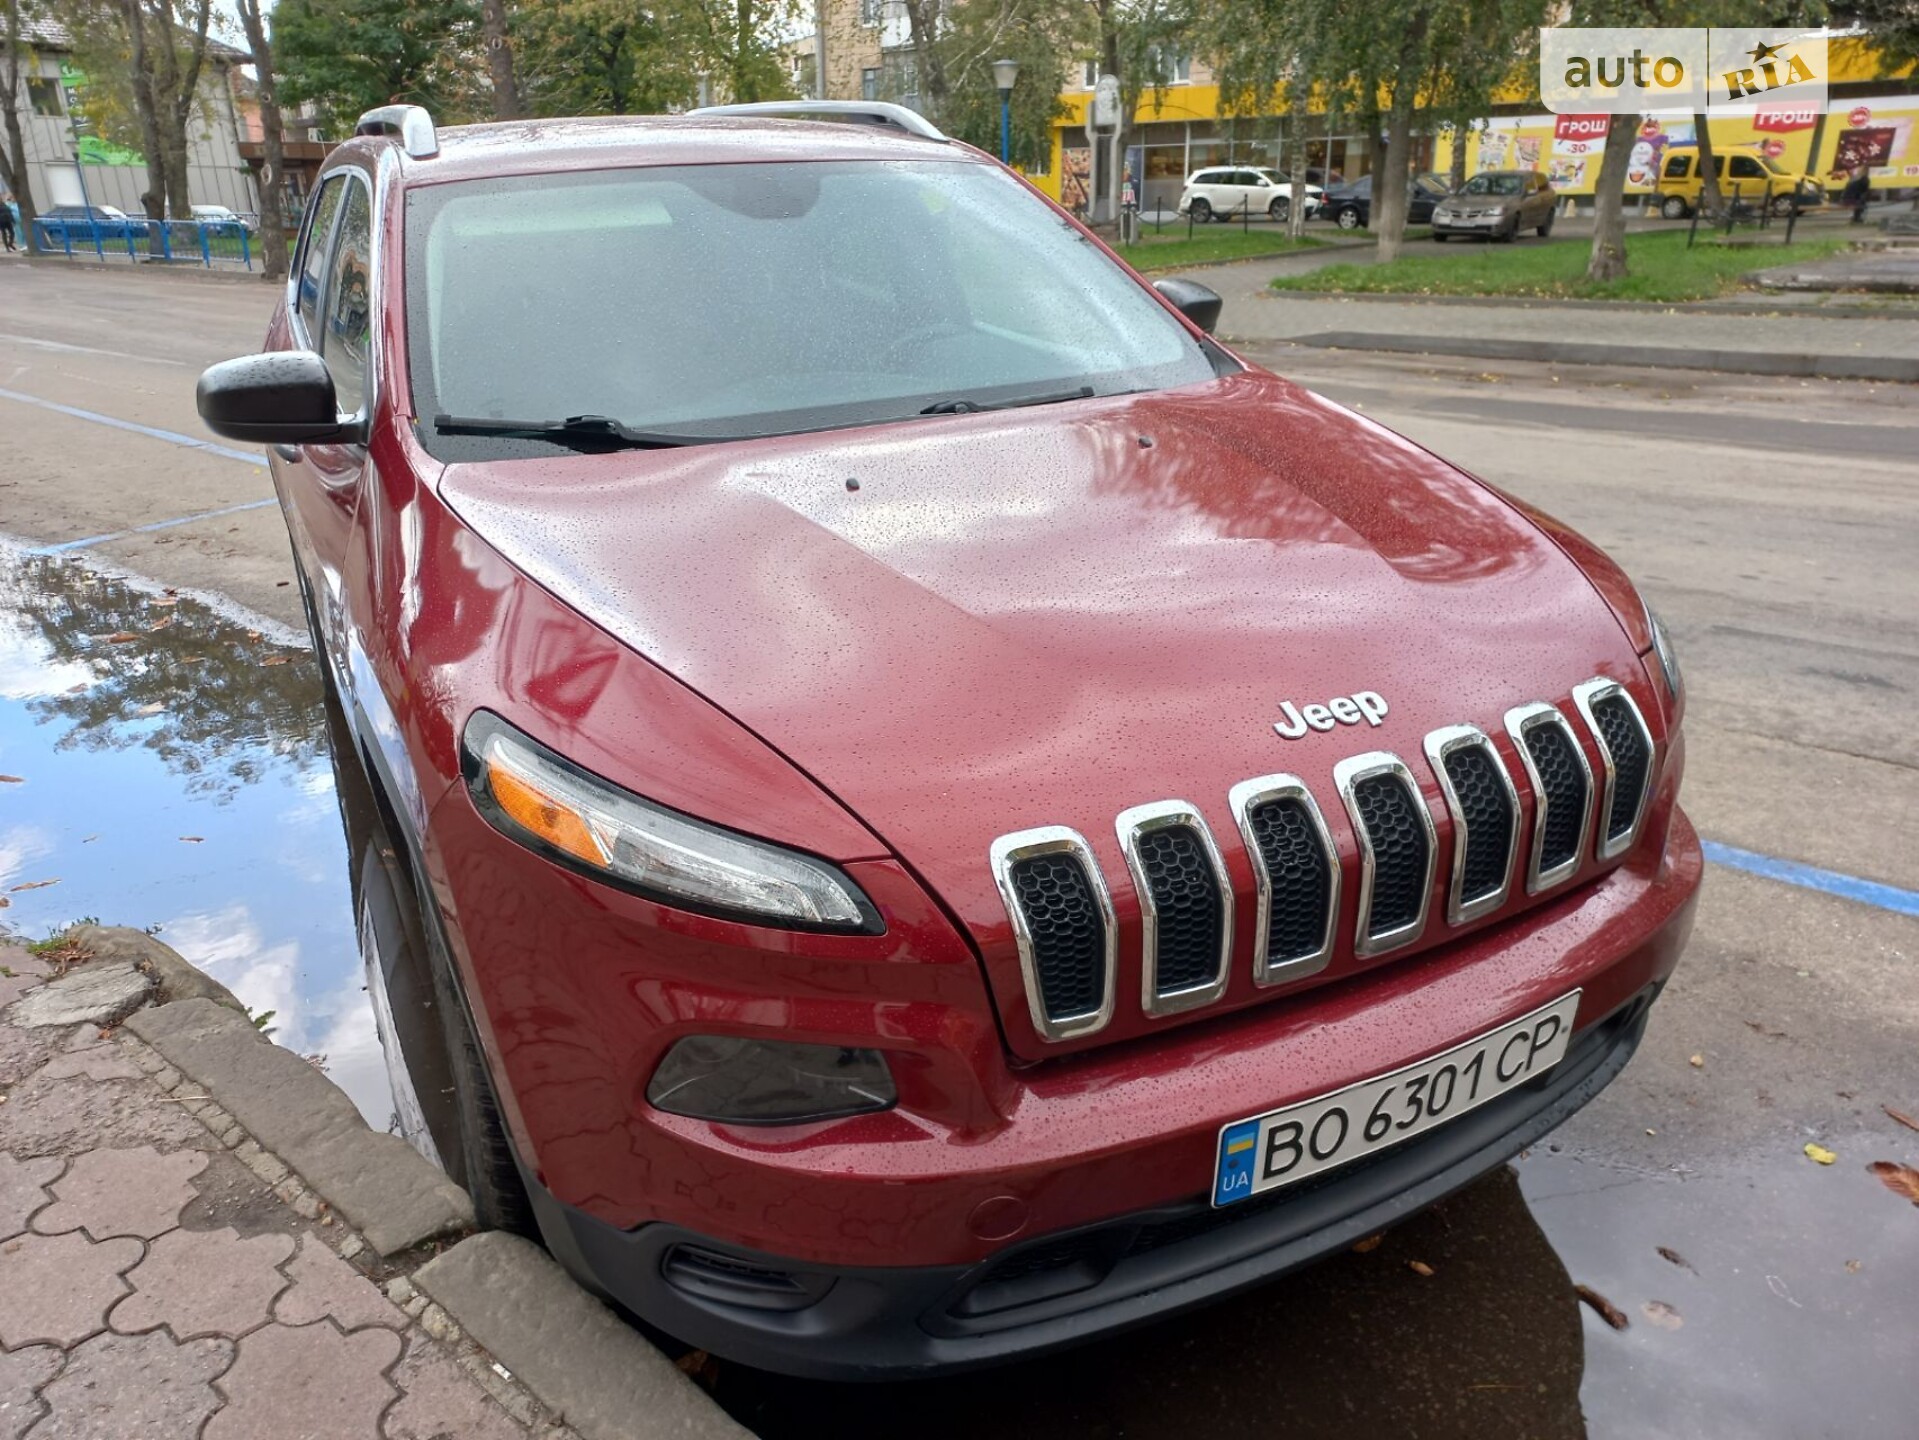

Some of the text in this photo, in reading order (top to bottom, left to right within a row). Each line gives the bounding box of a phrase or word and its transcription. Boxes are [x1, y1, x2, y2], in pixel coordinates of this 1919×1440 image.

[1559, 120, 1606, 134] ГРОШ
[1758, 110, 1815, 126] ГРОШ
[1273, 691, 1389, 740] Jeep
[1262, 1014, 1561, 1180] BO 6301 CP
[1223, 1170, 1249, 1192] UA
